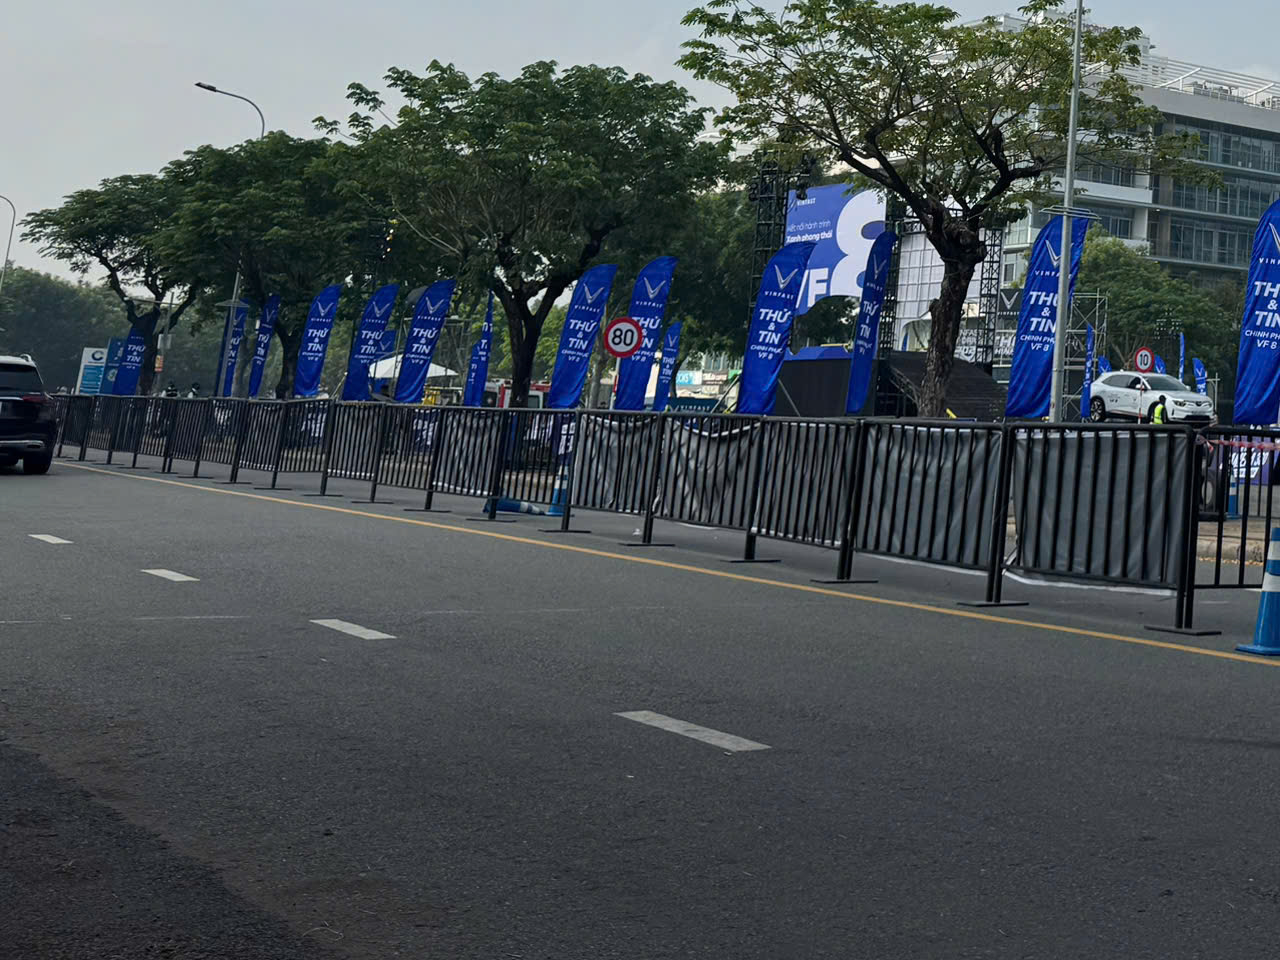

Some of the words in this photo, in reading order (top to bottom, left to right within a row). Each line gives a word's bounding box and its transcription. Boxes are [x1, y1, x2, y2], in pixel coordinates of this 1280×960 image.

[764, 290, 794, 300] VINFAST
[574, 304, 600, 313] VINFAST
[1267, 299, 1279, 311] &
[759, 307, 792, 323] THỬ
[1041, 306, 1051, 317] &
[569, 319, 597, 332] THỬ
[768, 322, 775, 331] &
[307, 327, 329, 338] THỬ
[361, 330, 384, 340] THỬ
[412, 327, 438, 339] THỬ
[611, 327, 635, 347] 80
[758, 330, 781, 345] TIN
[1020, 334, 1042, 342] CHINH
[1244, 329, 1269, 339] CHINH
[307, 343, 323, 352] TIN
[411, 343, 431, 354] TIN
[568, 337, 589, 350] TIN
[1030, 343, 1042, 351] VF
[1042, 344, 1050, 352] 8
[1256, 339, 1270, 348] VF
[1270, 341, 1278, 350] 8
[360, 345, 378, 354] TIN
[767, 352, 773, 360] 8
[1139, 354, 1149, 366] 10
